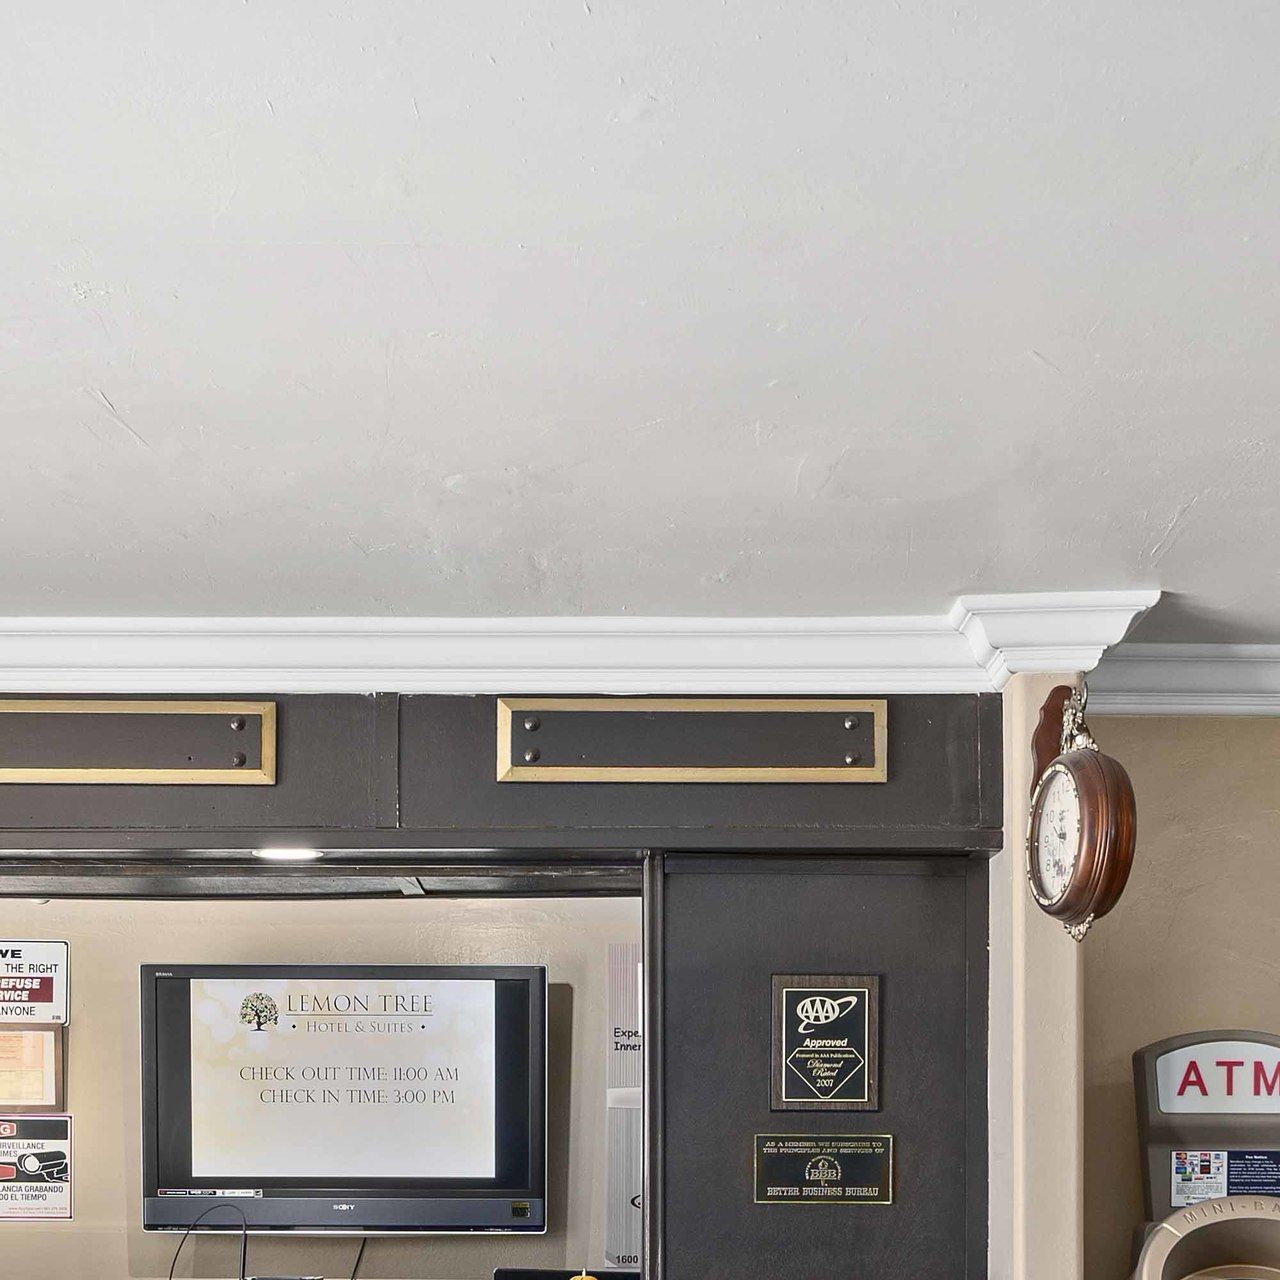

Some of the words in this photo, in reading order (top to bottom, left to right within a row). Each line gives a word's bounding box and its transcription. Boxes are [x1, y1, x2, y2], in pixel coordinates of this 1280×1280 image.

[1046, 810, 1054, 824] 10
[1046, 859, 1051, 872] 8
[5, 963, 24, 973] THE
[29, 963, 59, 973] RIGHT
[287, 995, 369, 1012] LEMON
[378, 995, 433, 1012] TREE
[355, 1021, 365, 1033] &
[614, 1027, 642, 1040] Expe
[614, 1041, 642, 1051] Inner
[803, 1038, 848, 1048] Approved
[240, 1067, 296, 1081] CHECK
[302, 1067, 340, 1081] OUT
[345, 1067, 388, 1081] TIME:
[433, 1067, 459, 1081] AM
[816, 1079, 834, 1087] 2007
[260, 1089, 317, 1104] CHECK
[322, 1090, 339, 1104] IN
[346, 1090, 388, 1104] TIME:
[393, 1090, 427, 1104] 3:00
[433, 1090, 455, 1104] PM
[810, 1169, 837, 1180] BBB
[24, 1185, 64, 1193] GRABANDO
[767, 1187, 800, 1196] BETTER
[803, 1187, 842, 1196] BUSINESS
[845, 1187, 879, 1196] BUREAU
[616, 1255, 639, 1264] 1600
